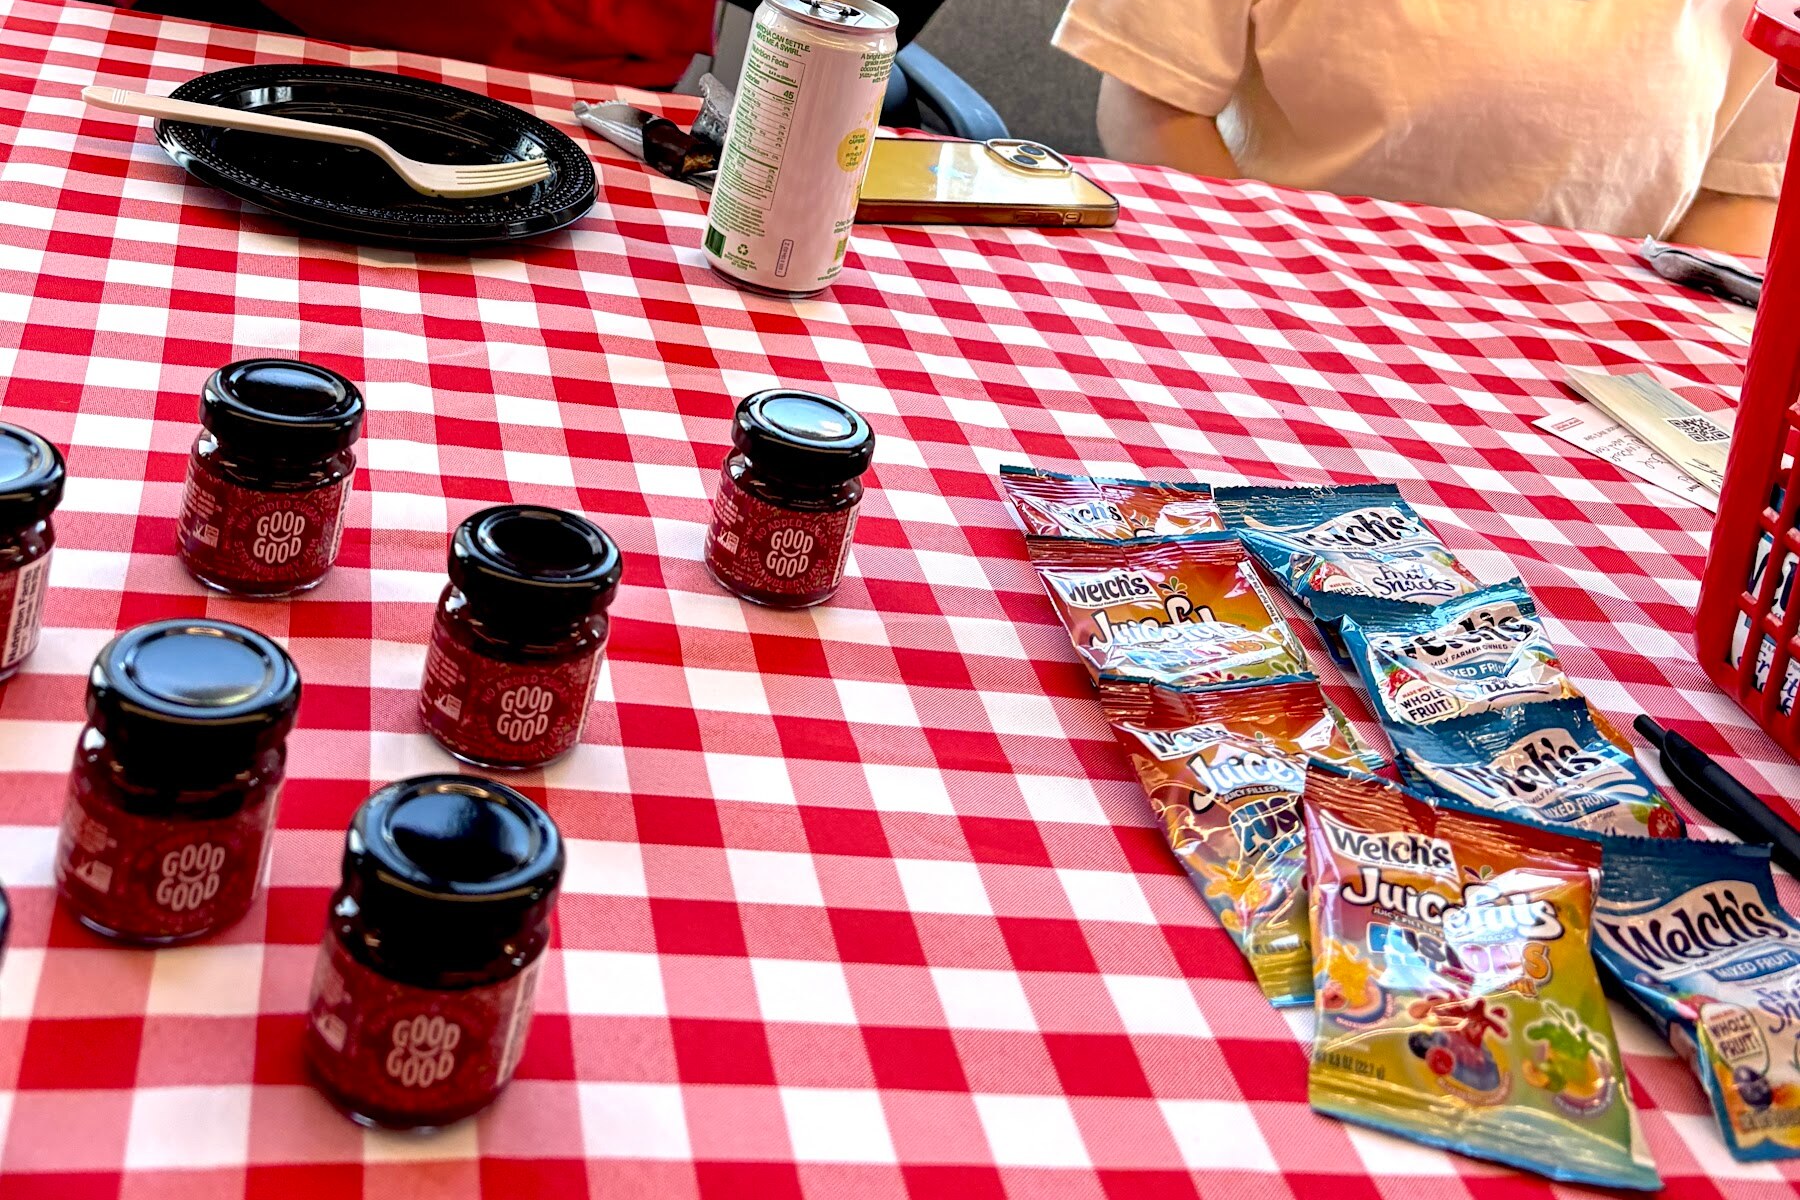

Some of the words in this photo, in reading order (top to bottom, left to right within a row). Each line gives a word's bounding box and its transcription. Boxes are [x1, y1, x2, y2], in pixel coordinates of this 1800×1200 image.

[772, 32, 785, 43] CAN
[771, 55, 789, 69] Facts
[252, 500, 291, 515] ADDED
[256, 511, 305, 537] GOOD
[754, 527, 767, 542] NO
[767, 518, 802, 531] ADDED
[253, 537, 302, 564] GOOD
[770, 528, 814, 554] GOOD
[750, 550, 807, 590] STRAWBERRY
[766, 550, 809, 578] GOOD
[1371, 576, 1457, 596] Snacks
[7, 607, 26, 662] Nutrition
[18, 568, 33, 606] Facts
[1451, 646, 1481, 661] FARMER
[501, 686, 553, 713] GOOD
[1401, 688, 1445, 709] WHOLE
[1408, 700, 1453, 721] FRUIT!
[497, 714, 549, 742] GOOD
[1245, 784, 1280, 798] FILLED
[162, 842, 226, 878] GOOD
[1327, 825, 1452, 869] Welch's
[156, 873, 220, 911] GOOD
[1341, 866, 1565, 940] Juicefuls
[1596, 889, 1789, 971] Welch's
[1713, 961, 1757, 977] MIXED
[1755, 951, 1793, 970] FRUIT
[391, 1014, 461, 1050] GOOD
[1710, 1014, 1751, 1039] WHOLE
[386, 1047, 455, 1087] GOOD
